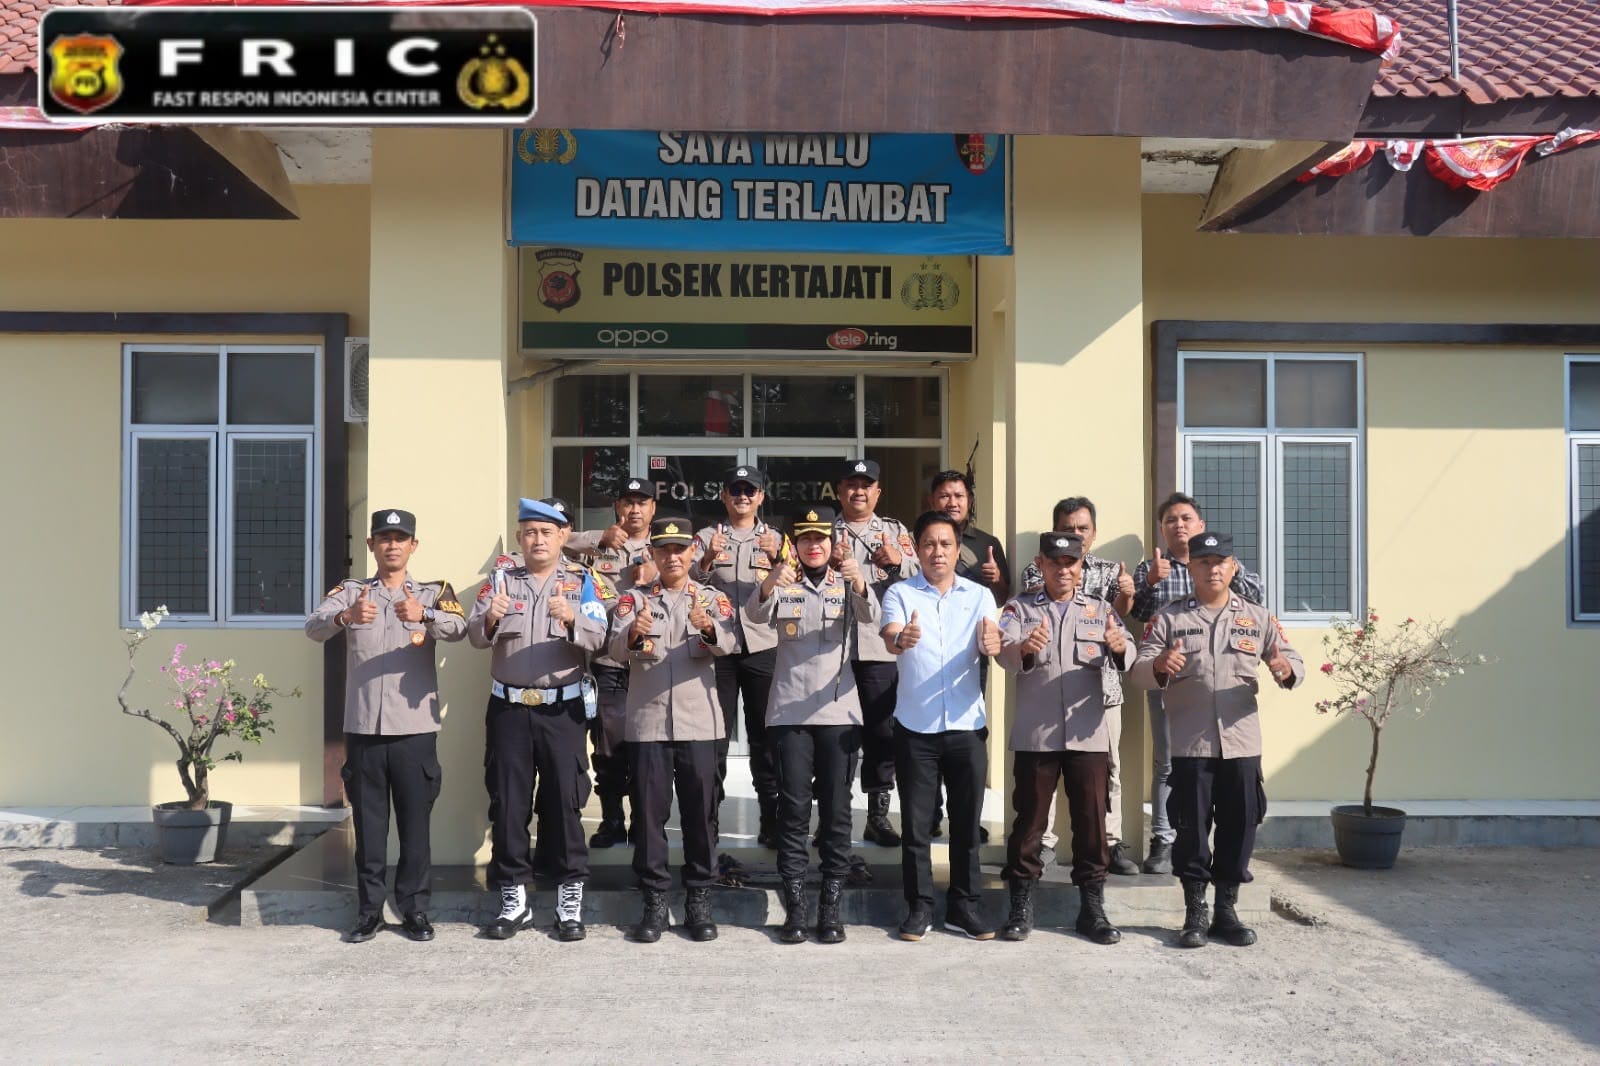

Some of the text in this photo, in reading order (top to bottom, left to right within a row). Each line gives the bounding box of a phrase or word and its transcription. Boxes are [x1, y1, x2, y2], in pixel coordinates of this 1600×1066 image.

[658, 131, 871, 168] SAYA MALU
[575, 177, 951, 223] DATANG TERLAMBAT
[603, 262, 892, 300] POLSEK KERTAJATI
[596, 329, 669, 347] oppo
[1230, 627, 1261, 638] POLRI
